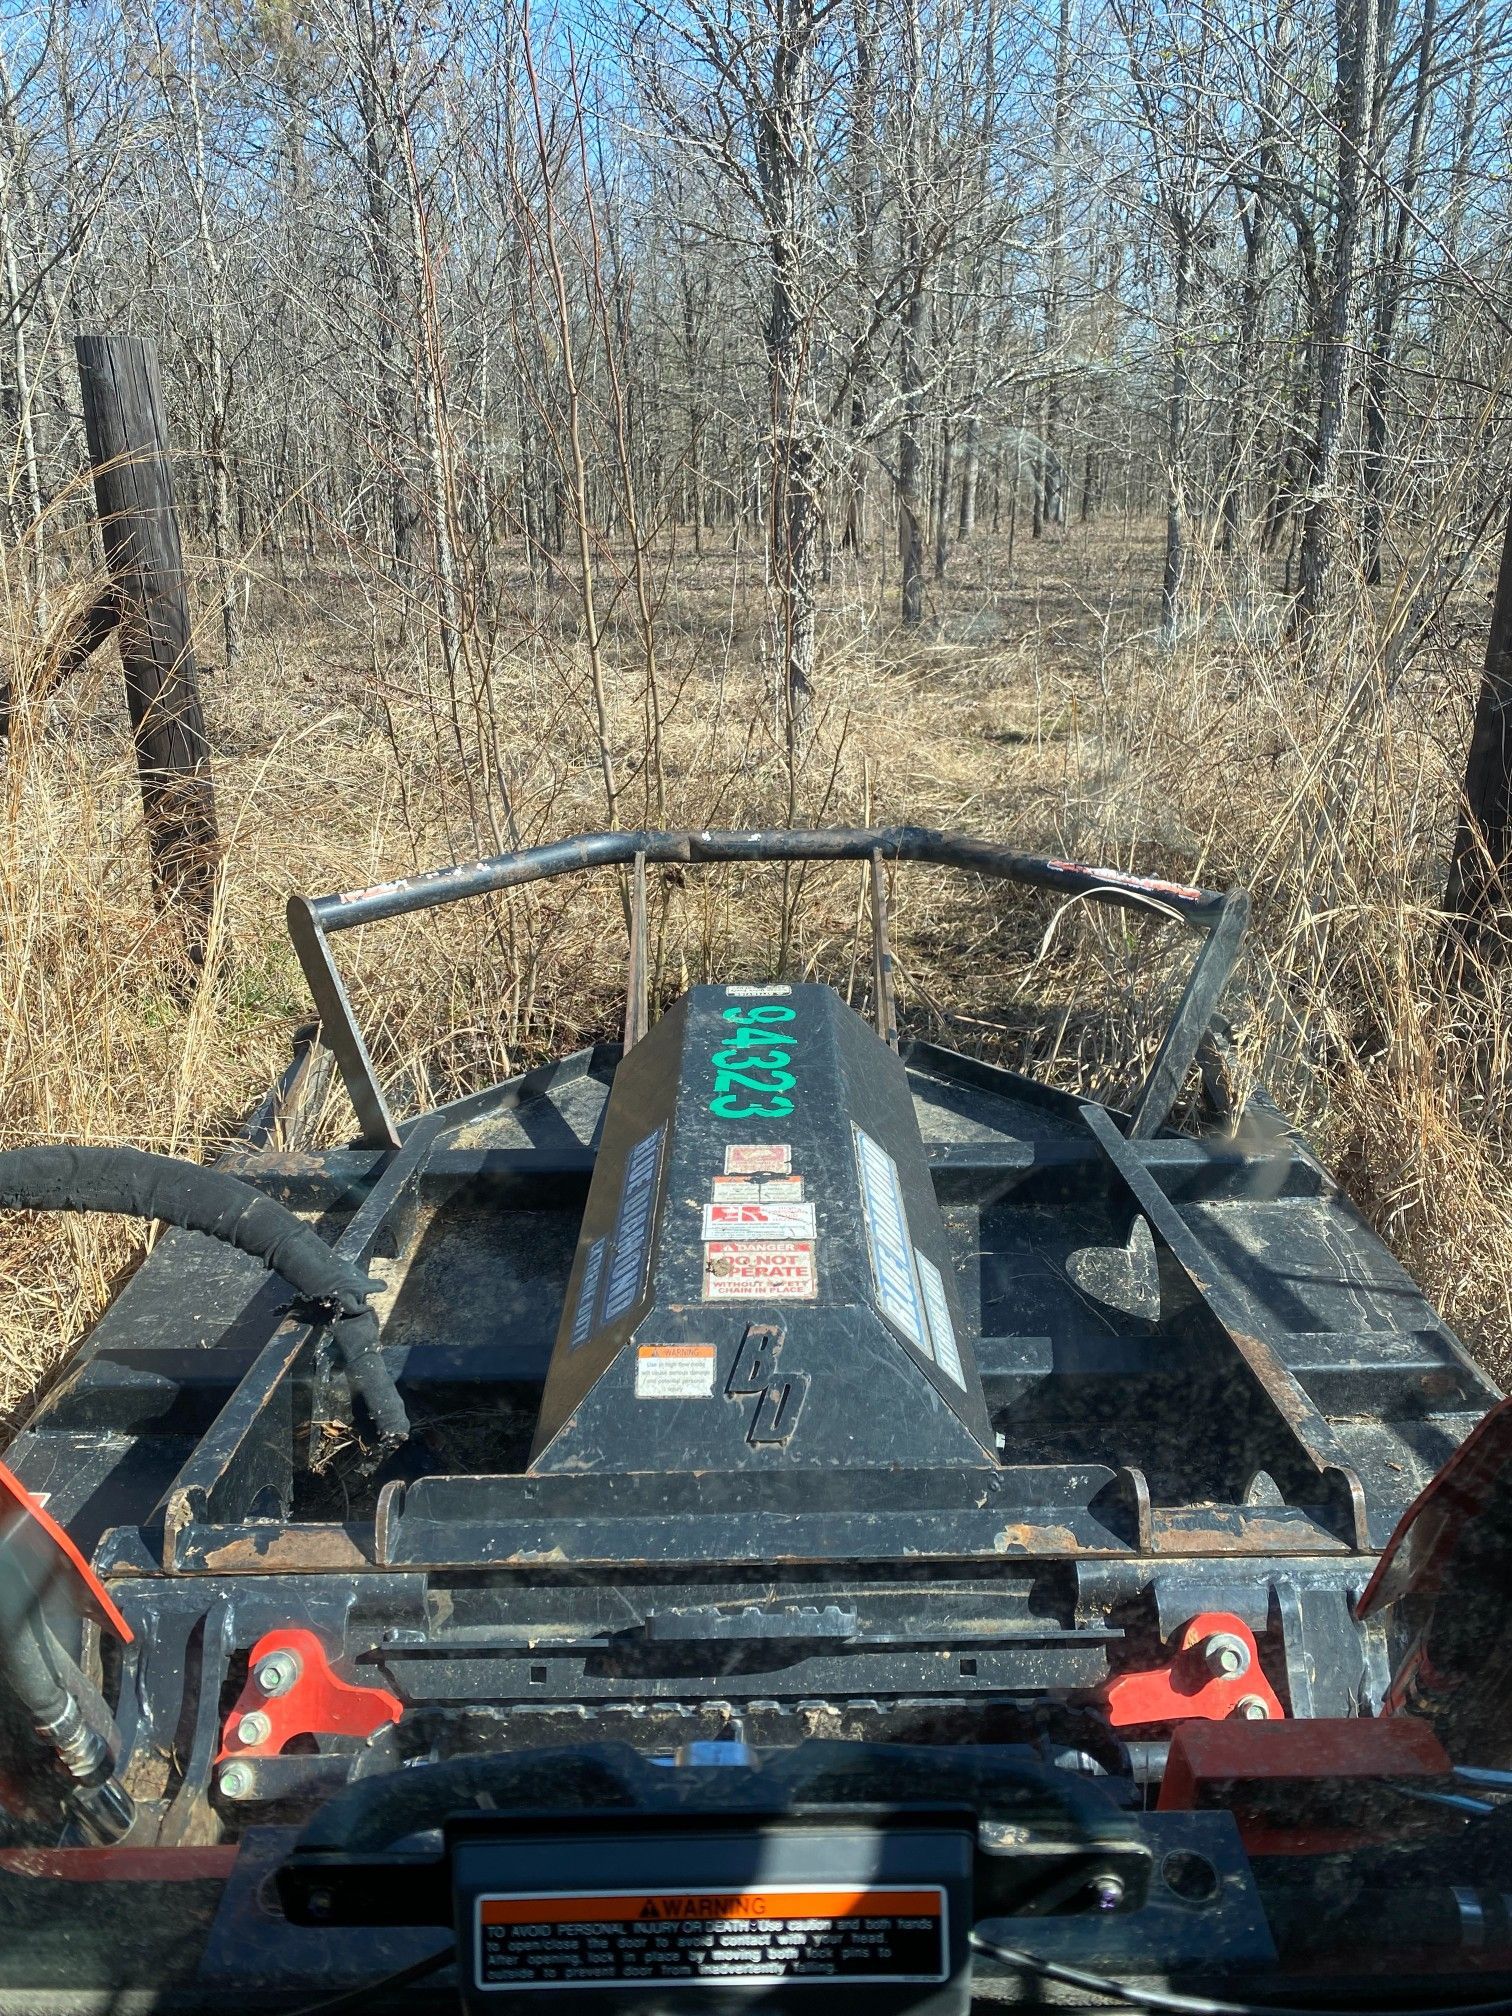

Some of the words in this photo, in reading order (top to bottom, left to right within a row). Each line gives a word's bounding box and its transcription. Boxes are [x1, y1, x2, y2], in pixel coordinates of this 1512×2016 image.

[709, 1005, 798, 1119] 94323
[626, 1130, 658, 1196] BLUE
[861, 1134, 907, 1266] DIAMOND
[605, 1184, 650, 1320] DIAMOND
[714, 1266, 808, 1277] PERATE
[756, 1256, 799, 1265] NOT
[877, 1242, 920, 1342] BLUE
[487, 1926, 506, 1937] TO
[512, 1925, 551, 1936] AVOID
[558, 1923, 627, 1935] PERSONAL
[836, 1919, 860, 1930] and
[865, 1918, 891, 1929] both
[661, 1898, 767, 1915] WARNING
